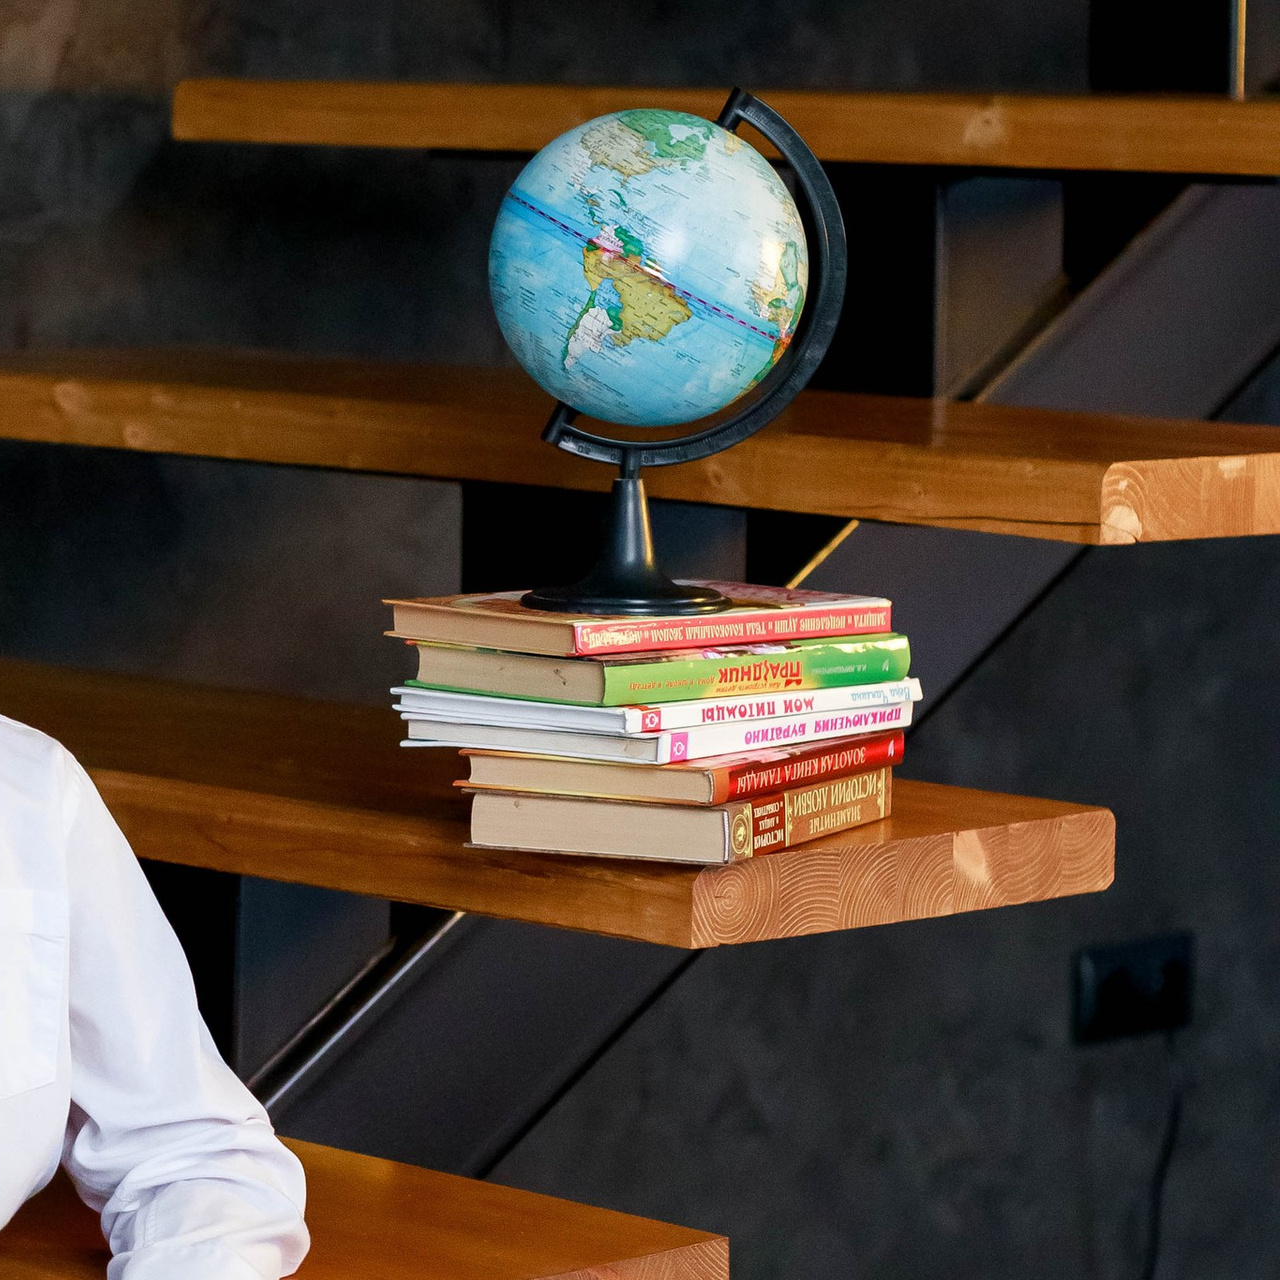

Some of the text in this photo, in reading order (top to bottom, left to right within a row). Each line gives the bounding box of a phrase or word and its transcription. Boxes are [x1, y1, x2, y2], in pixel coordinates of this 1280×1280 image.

[718, 660, 802, 683] ПРАЗДНИК
[702, 701, 775, 722] ПИТОМЦЫ
[744, 708, 901, 745] ПРИКЛЮЧЕНИЯ БУРАТИНО
[737, 747, 866, 793] ЗОЛОТАЯ КНИГА ТАМАДЫ
[794, 773, 877, 817] ИСТОРИИ ЛЮБВИ
[810, 804, 861, 834] ЗНАМЕНИТЫЕ
[754, 829, 784, 849] ИСТОРИЯ
